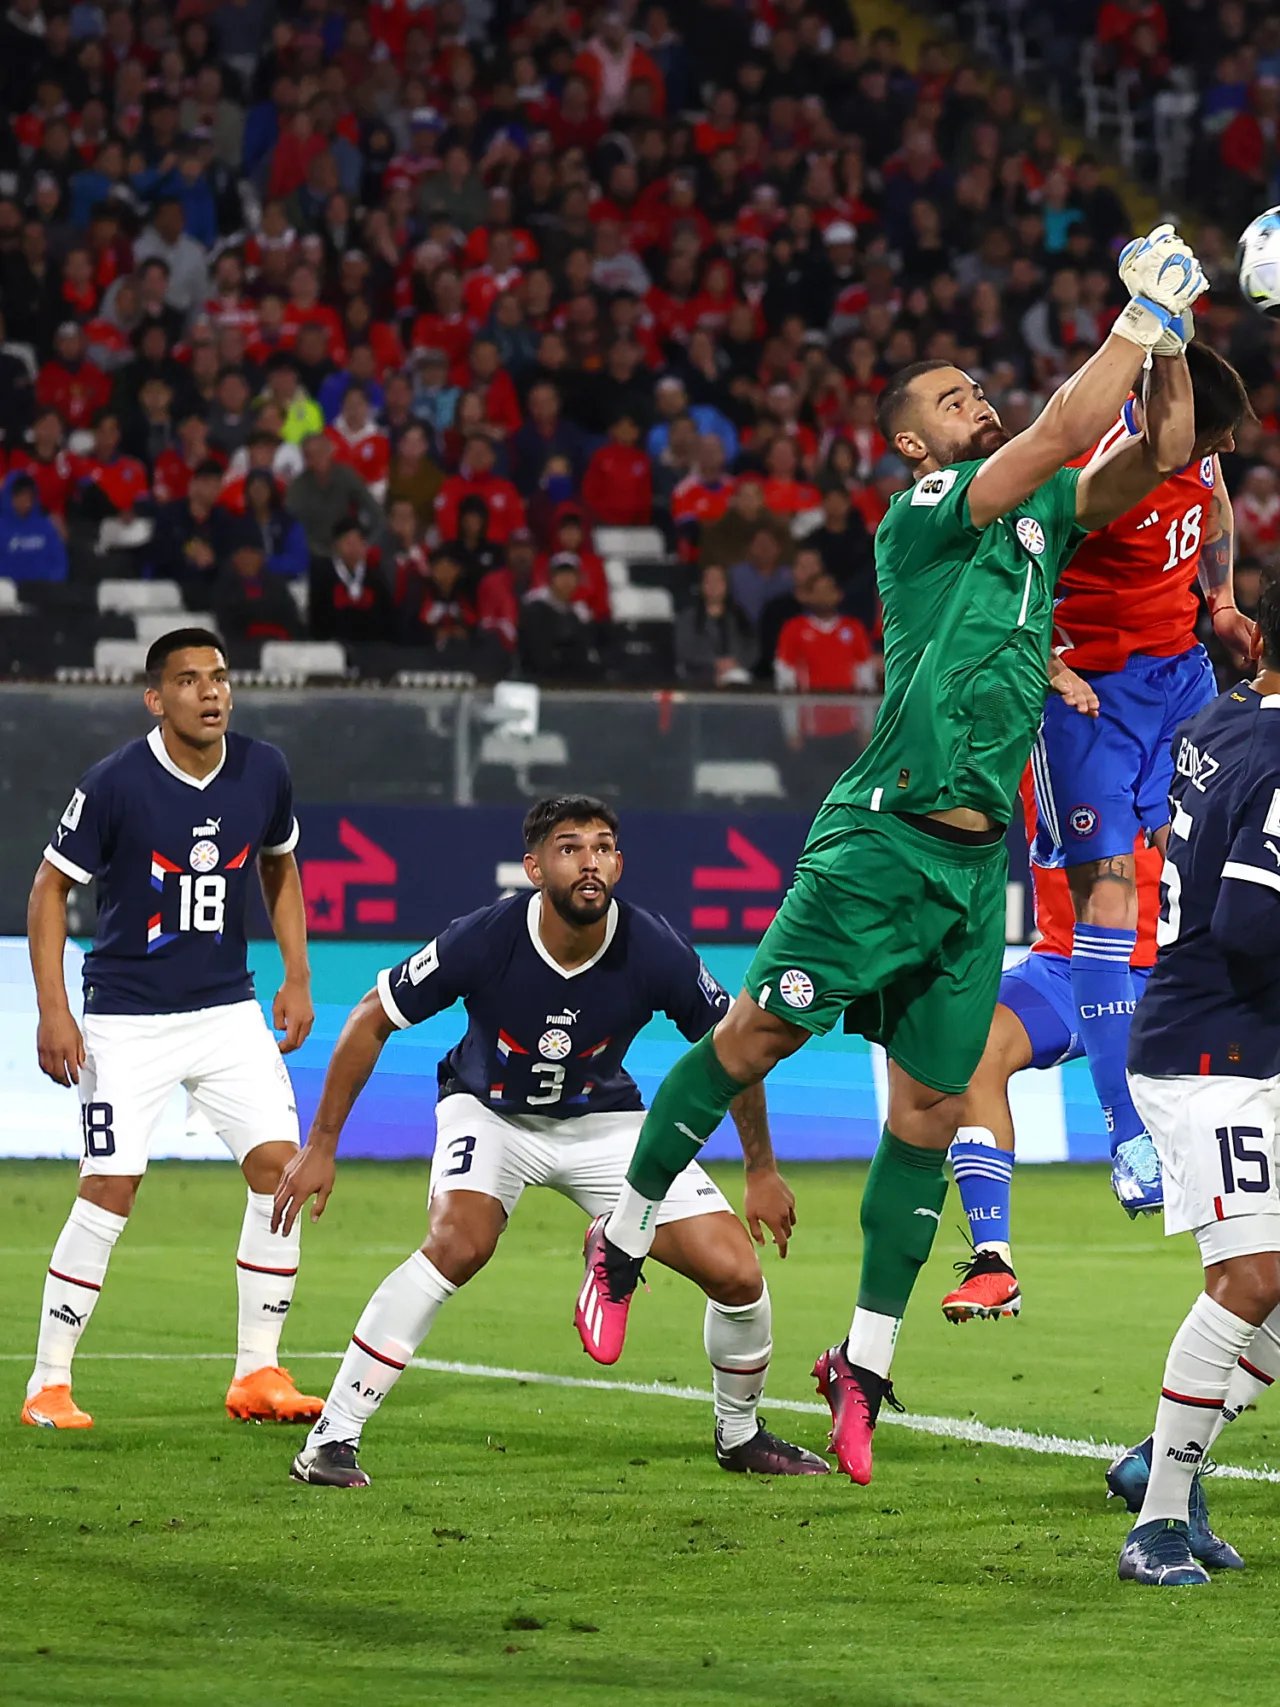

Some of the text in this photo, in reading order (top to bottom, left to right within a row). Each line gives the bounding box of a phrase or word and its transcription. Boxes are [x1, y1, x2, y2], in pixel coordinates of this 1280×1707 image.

[1163, 504, 1203, 572] 18
[1016, 561, 1033, 627] 1
[193, 826, 216, 837] PUMA
[179, 874, 226, 931] 18
[546, 1015, 573, 1026] PUMA
[526, 1062, 566, 1106] 3
[81, 1103, 116, 1157] 18
[441, 1135, 477, 1177] 3
[1215, 1126, 1270, 1194] 15
[967, 1206, 1002, 1221] HILE
[50, 1308, 76, 1326] PUMA
